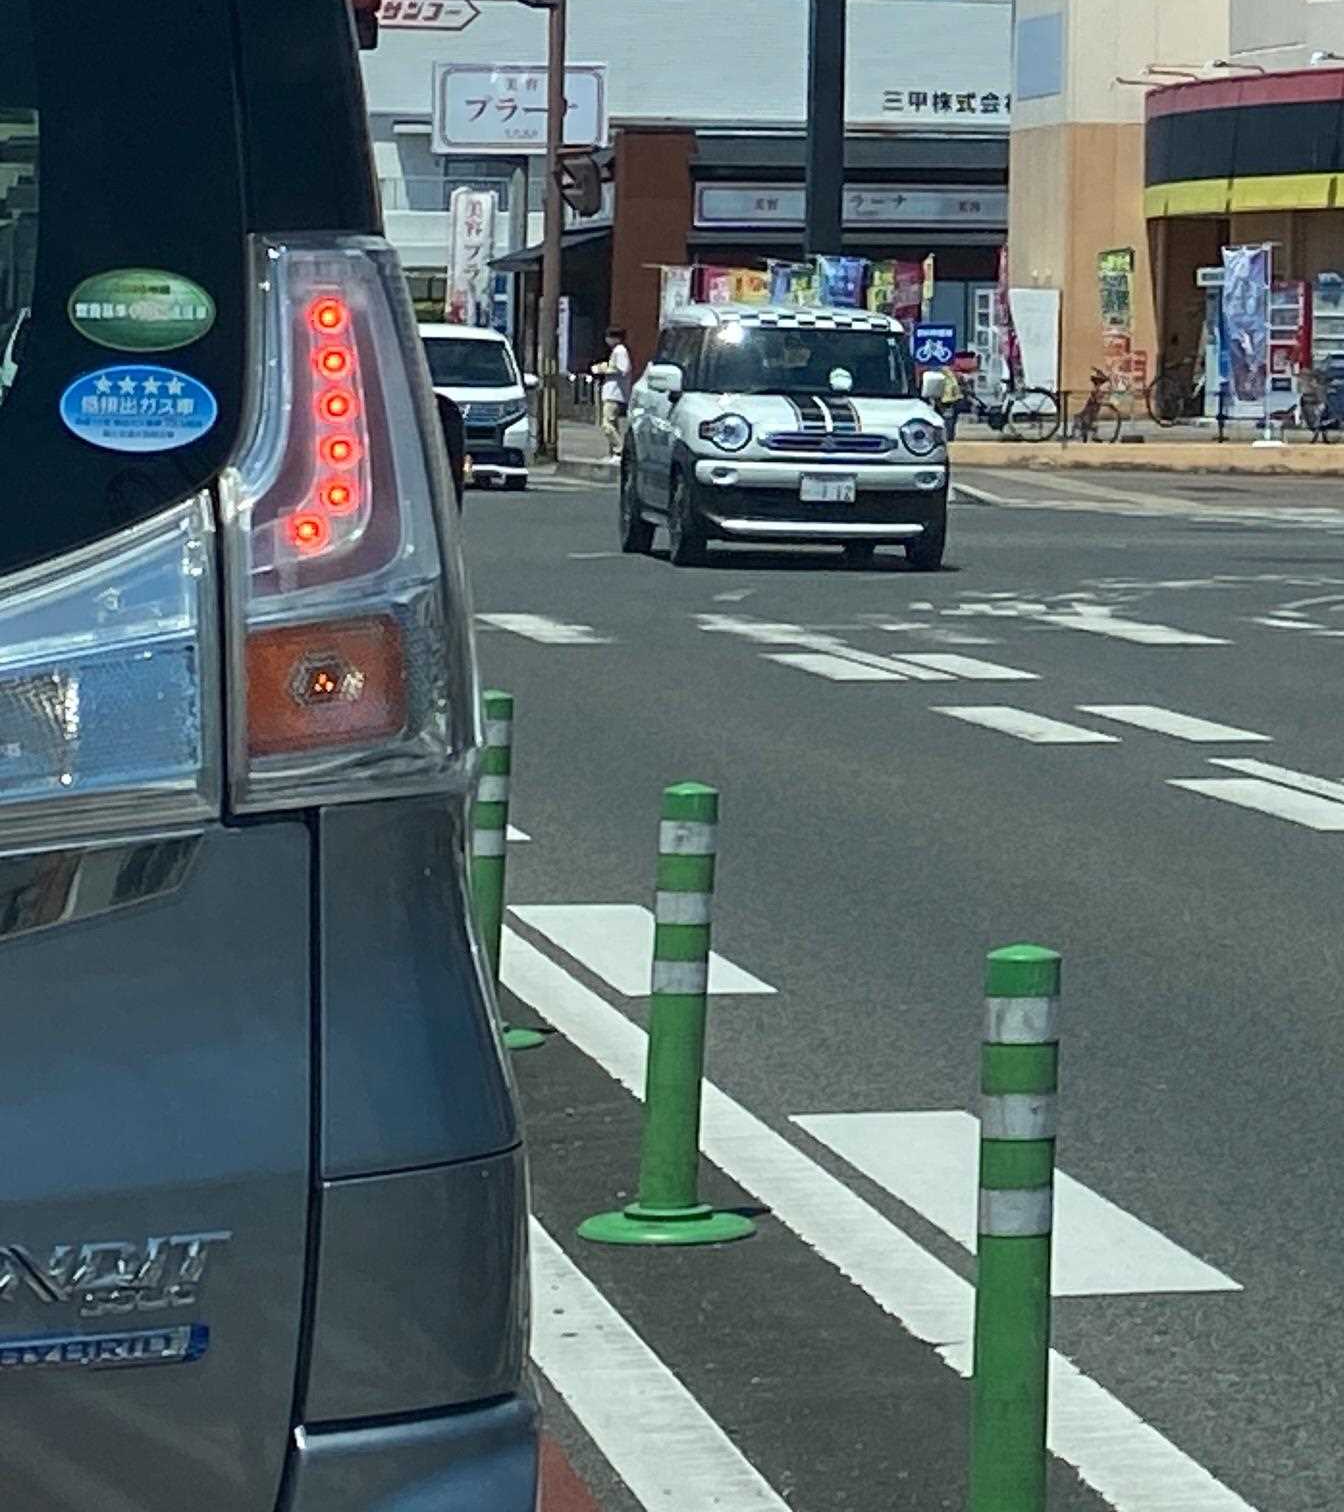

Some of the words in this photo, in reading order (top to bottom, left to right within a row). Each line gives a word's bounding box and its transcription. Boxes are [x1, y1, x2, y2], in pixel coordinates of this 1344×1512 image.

[381, 0, 462, 22] サンコー
[465, 94, 579, 122] プラー
